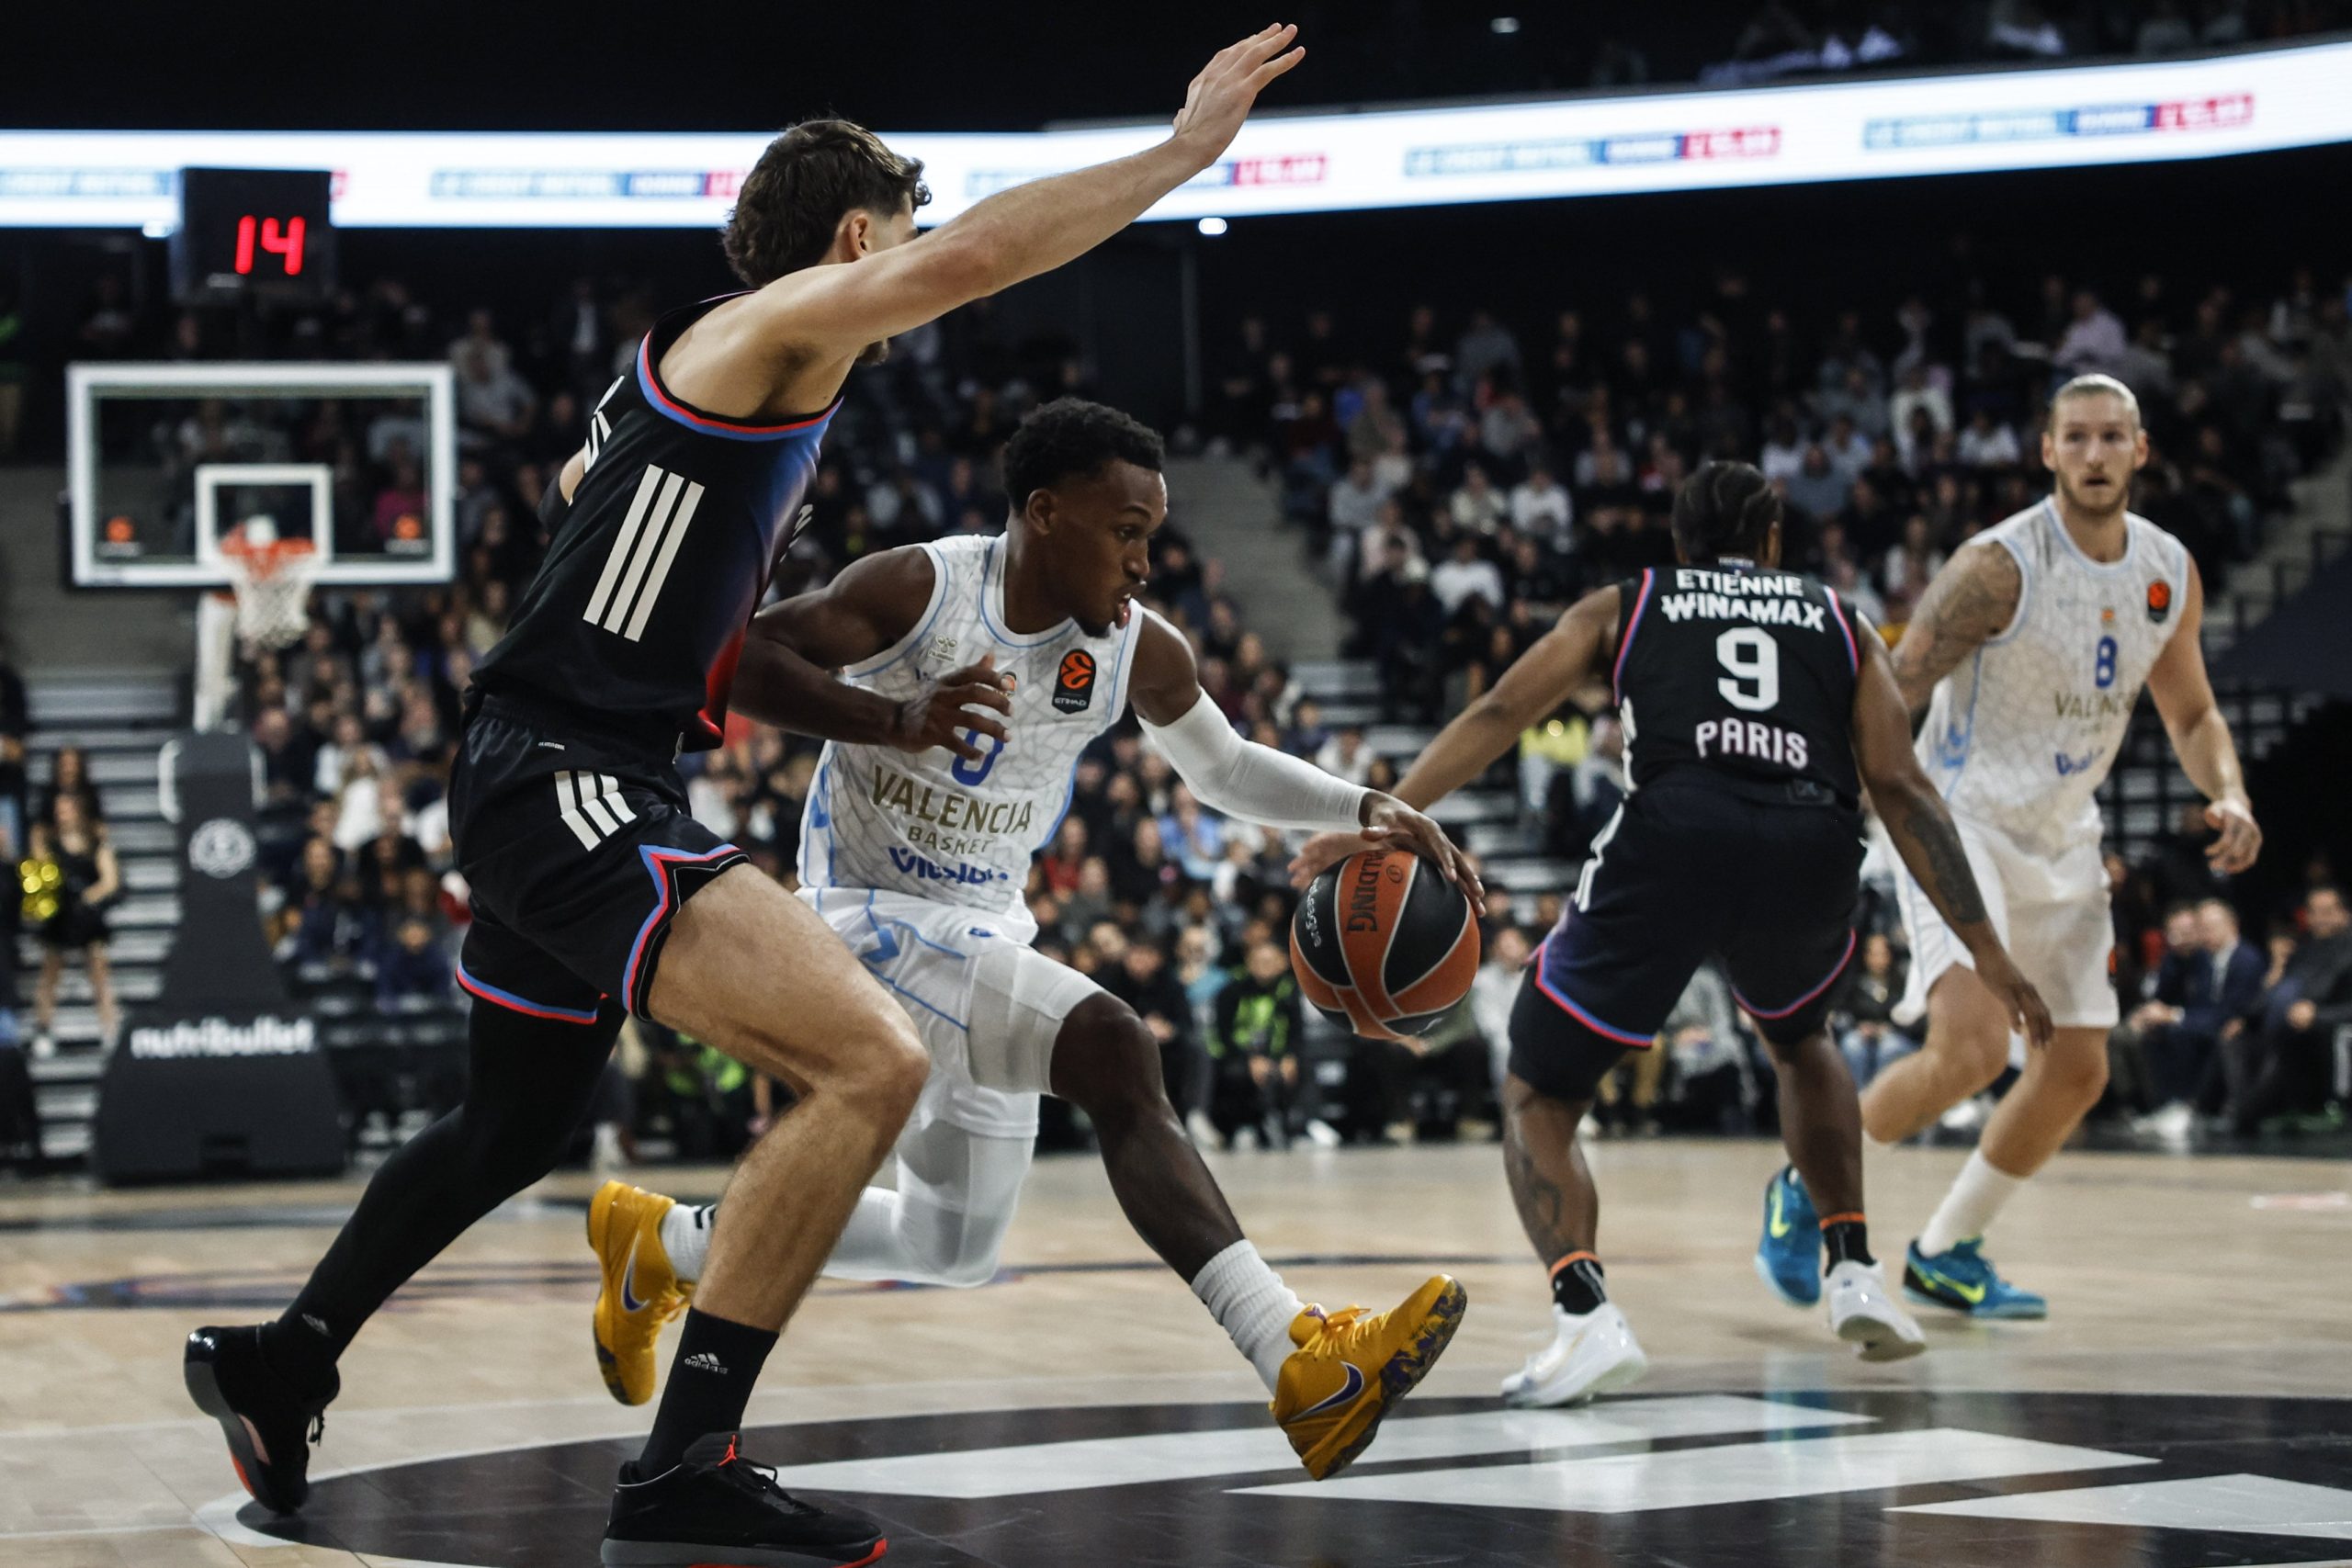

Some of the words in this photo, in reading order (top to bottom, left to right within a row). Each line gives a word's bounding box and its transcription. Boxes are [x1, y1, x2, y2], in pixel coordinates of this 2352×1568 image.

[234, 215, 305, 276] 14
[1661, 592, 1826, 634] WINAMAX
[1715, 626, 1780, 712] 9
[2095, 636, 2118, 688] 8
[1695, 717, 1808, 769] PARIS
[873, 764, 1033, 834] VALENCIA
[907, 827, 994, 854] BASKET
[684, 1358, 728, 1374] adidas
